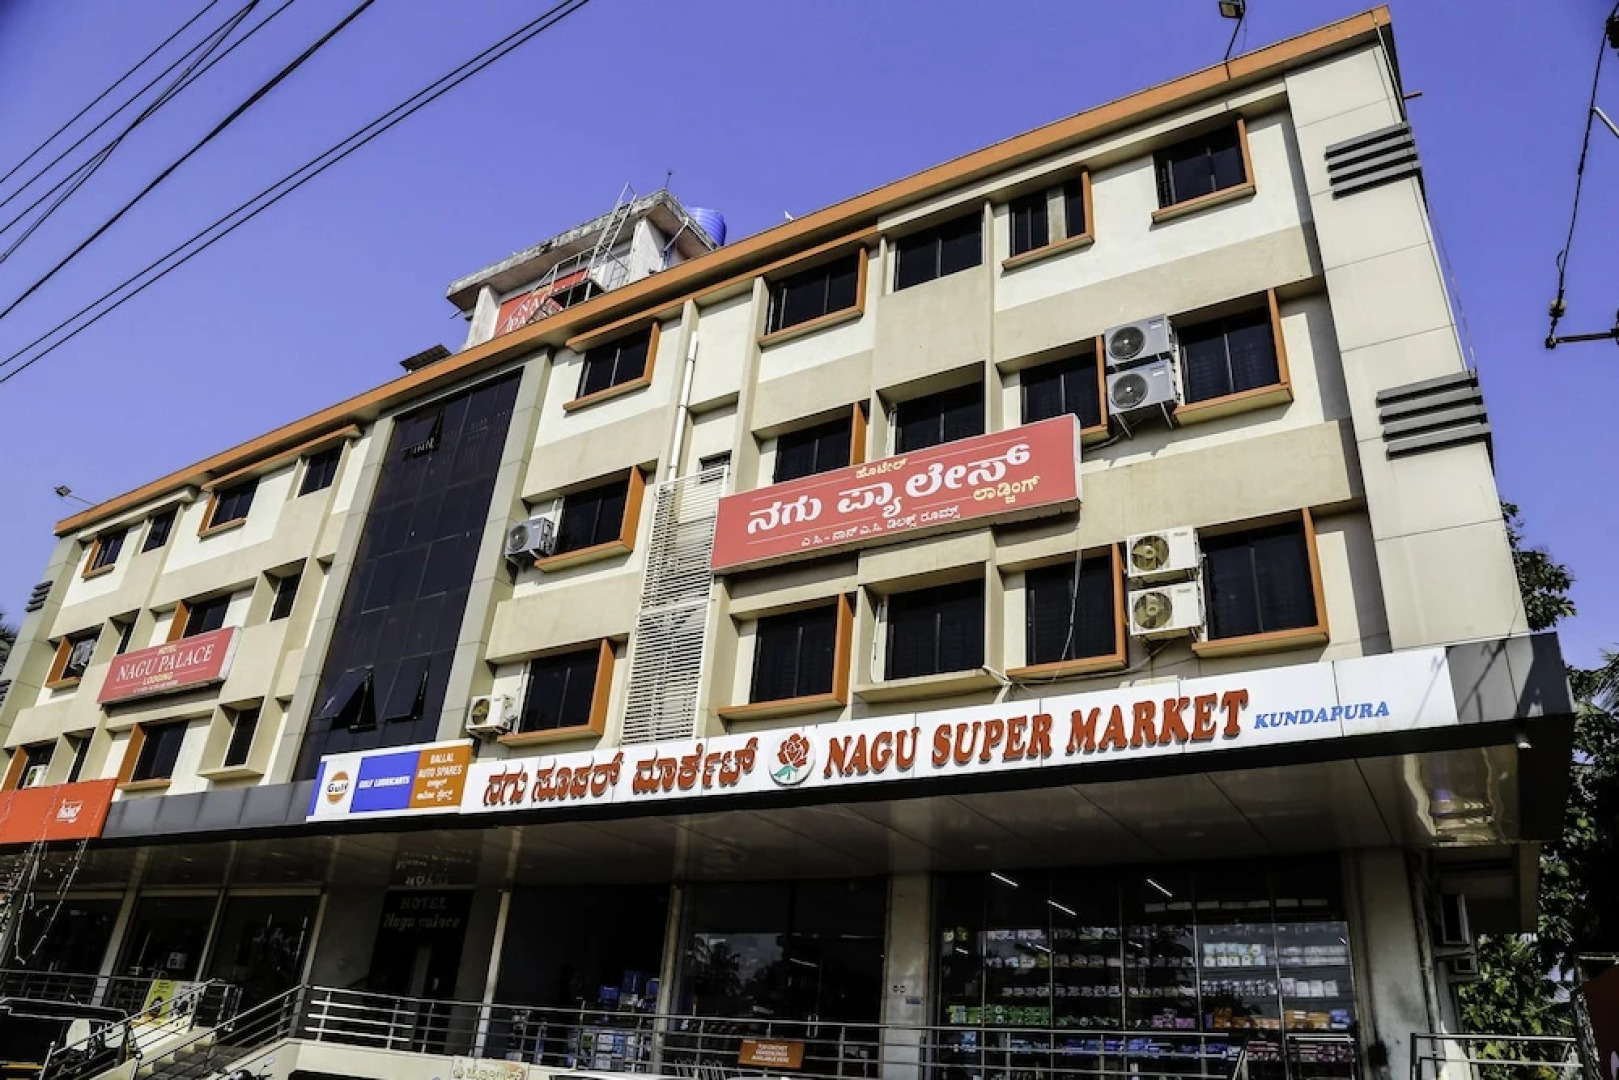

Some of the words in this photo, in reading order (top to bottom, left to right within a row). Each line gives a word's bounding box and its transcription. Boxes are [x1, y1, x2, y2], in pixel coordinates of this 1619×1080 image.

[747, 494, 822, 535] ನಗು
[116, 659, 158, 682] NAGU
[158, 643, 215, 673] PALACE
[823, 726, 920, 778] NAGU
[931, 713, 1053, 766] SUPER
[1064, 689, 1249, 757] MARKET
[1253, 701, 1390, 730] KUNDAPURA
[327, 782, 348, 793] Gulf
[484, 771, 529, 806] ನಗು
[532, 751, 624, 803] ಸೂಪರ್
[632, 737, 759, 795] ಮಾರ್ಕೆಟ್
